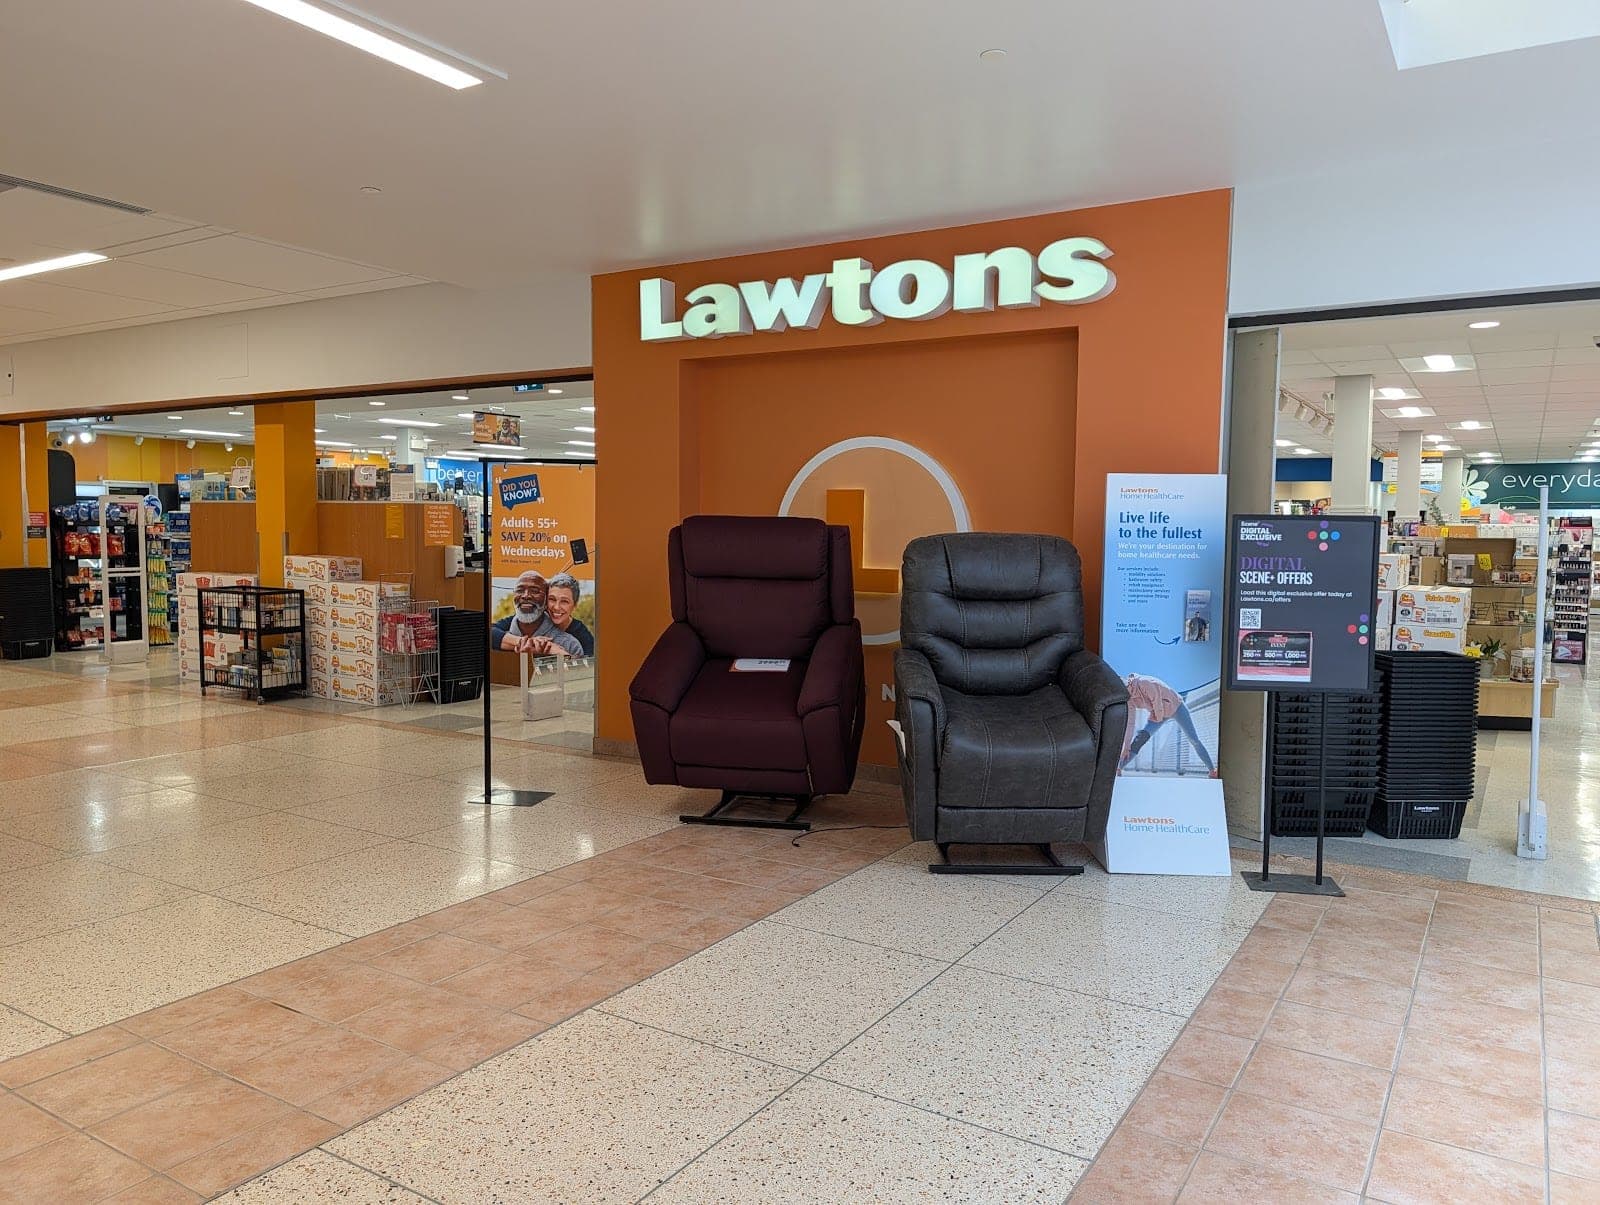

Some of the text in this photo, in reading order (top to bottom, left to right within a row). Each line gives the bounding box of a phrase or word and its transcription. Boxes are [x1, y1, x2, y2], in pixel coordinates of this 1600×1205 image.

[639, 236, 1117, 342] Lawtons
[502, 480, 536, 493] DID YOU
[503, 487, 538, 502] KNOW?
[501, 517, 558, 529] Adults 55+
[1119, 512, 1170, 524] Live life
[501, 531, 567, 543] SAVE 20% on
[1118, 526, 1202, 539] to the fullest
[501, 545, 565, 559] Wednesdays
[1240, 557, 1306, 570] DIGITAL
[1240, 571, 1312, 584] SCENE+ OFFERS
[1124, 816, 1176, 824] Lawtons
[1124, 824, 1210, 834] Home HealthCare
